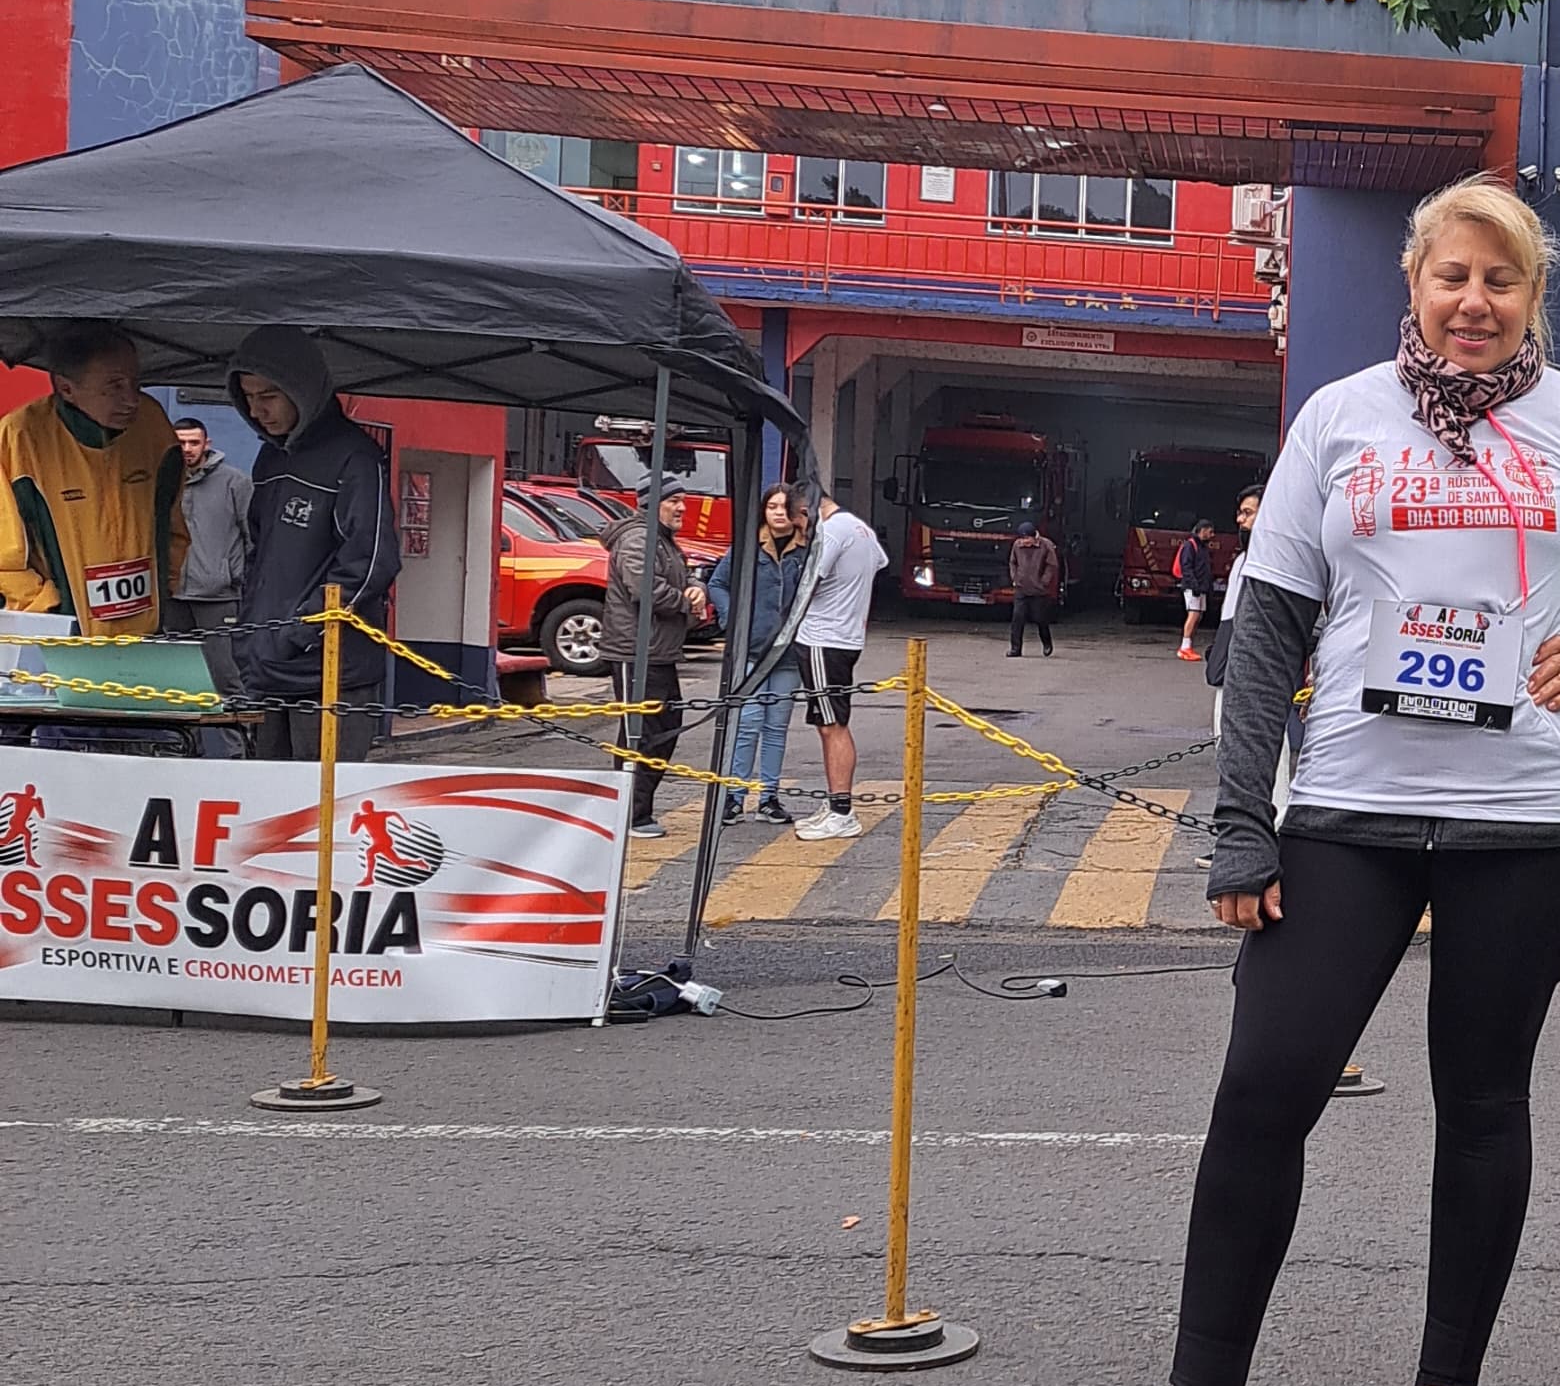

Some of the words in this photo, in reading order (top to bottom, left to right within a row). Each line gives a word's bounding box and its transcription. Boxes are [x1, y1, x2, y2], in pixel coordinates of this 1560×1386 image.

[1447, 491, 1462, 503] DE
[1407, 508, 1433, 527] DIA
[1438, 508, 1458, 526] DO
[95, 574, 145, 603] 100
[1399, 621, 1485, 644] ASSESSORIA
[1396, 649, 1485, 692] 296
[1398, 694, 1477, 714] EVOLUTION
[41, 947, 161, 976] ESPORTIVA
[166, 956, 180, 976] E
[183, 958, 402, 988] CRONOMETAGEM
